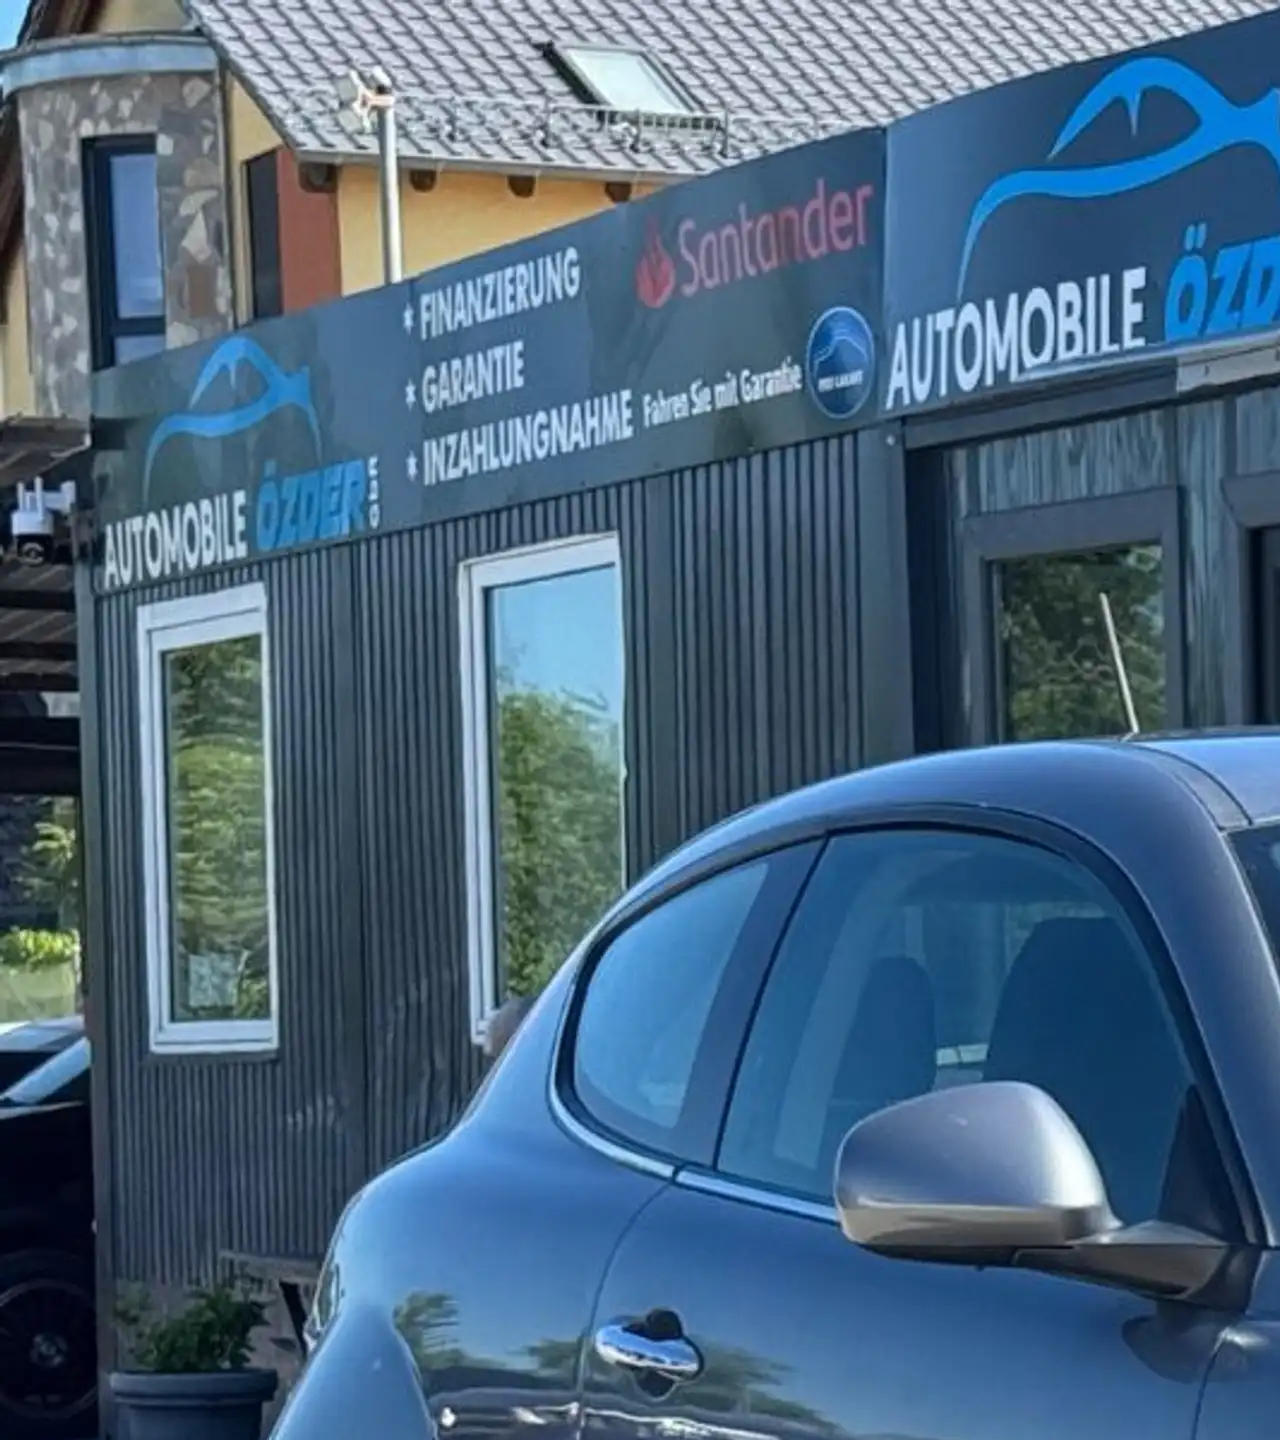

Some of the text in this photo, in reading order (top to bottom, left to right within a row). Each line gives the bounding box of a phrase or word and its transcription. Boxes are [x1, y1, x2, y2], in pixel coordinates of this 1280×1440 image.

[678, 177, 874, 297] Santander
[420, 246, 581, 341] FINANZIERUNG
[884, 266, 1147, 410] AUTOMOBILE
[422, 340, 525, 414] GARANTIE
[643, 389, 690, 429] Fahren
[690, 378, 713, 416] Sie
[714, 370, 740, 411] mit
[740, 355, 803, 404] Garantie
[423, 388, 635, 487] INZAHLUNGNAHME
[104, 458, 367, 590] AUTOMOBILE ÖZDER
